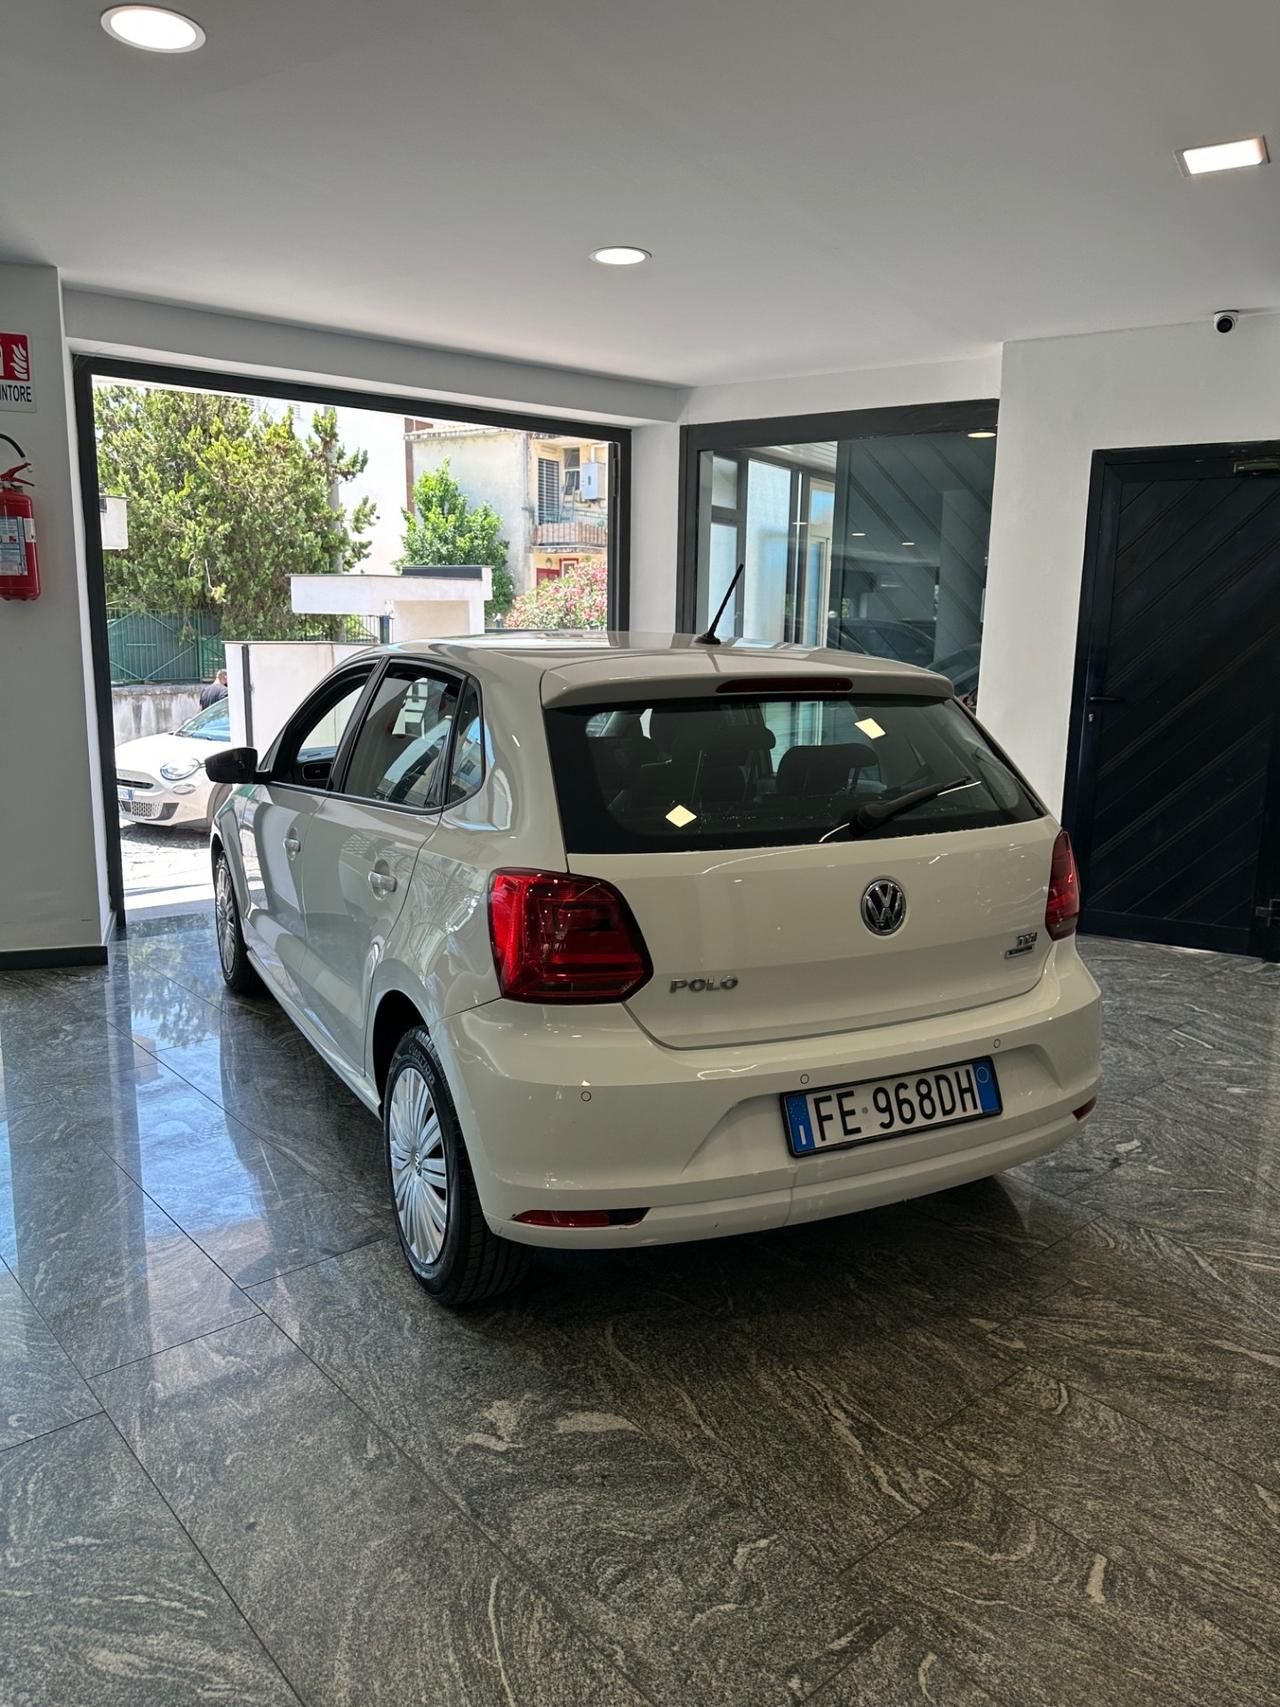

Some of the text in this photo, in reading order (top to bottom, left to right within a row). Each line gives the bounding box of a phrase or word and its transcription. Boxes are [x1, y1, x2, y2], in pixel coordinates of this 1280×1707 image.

[669, 976, 739, 994] POLO
[813, 1090, 862, 1142] FE
[872, 1068, 979, 1130] 968DH
